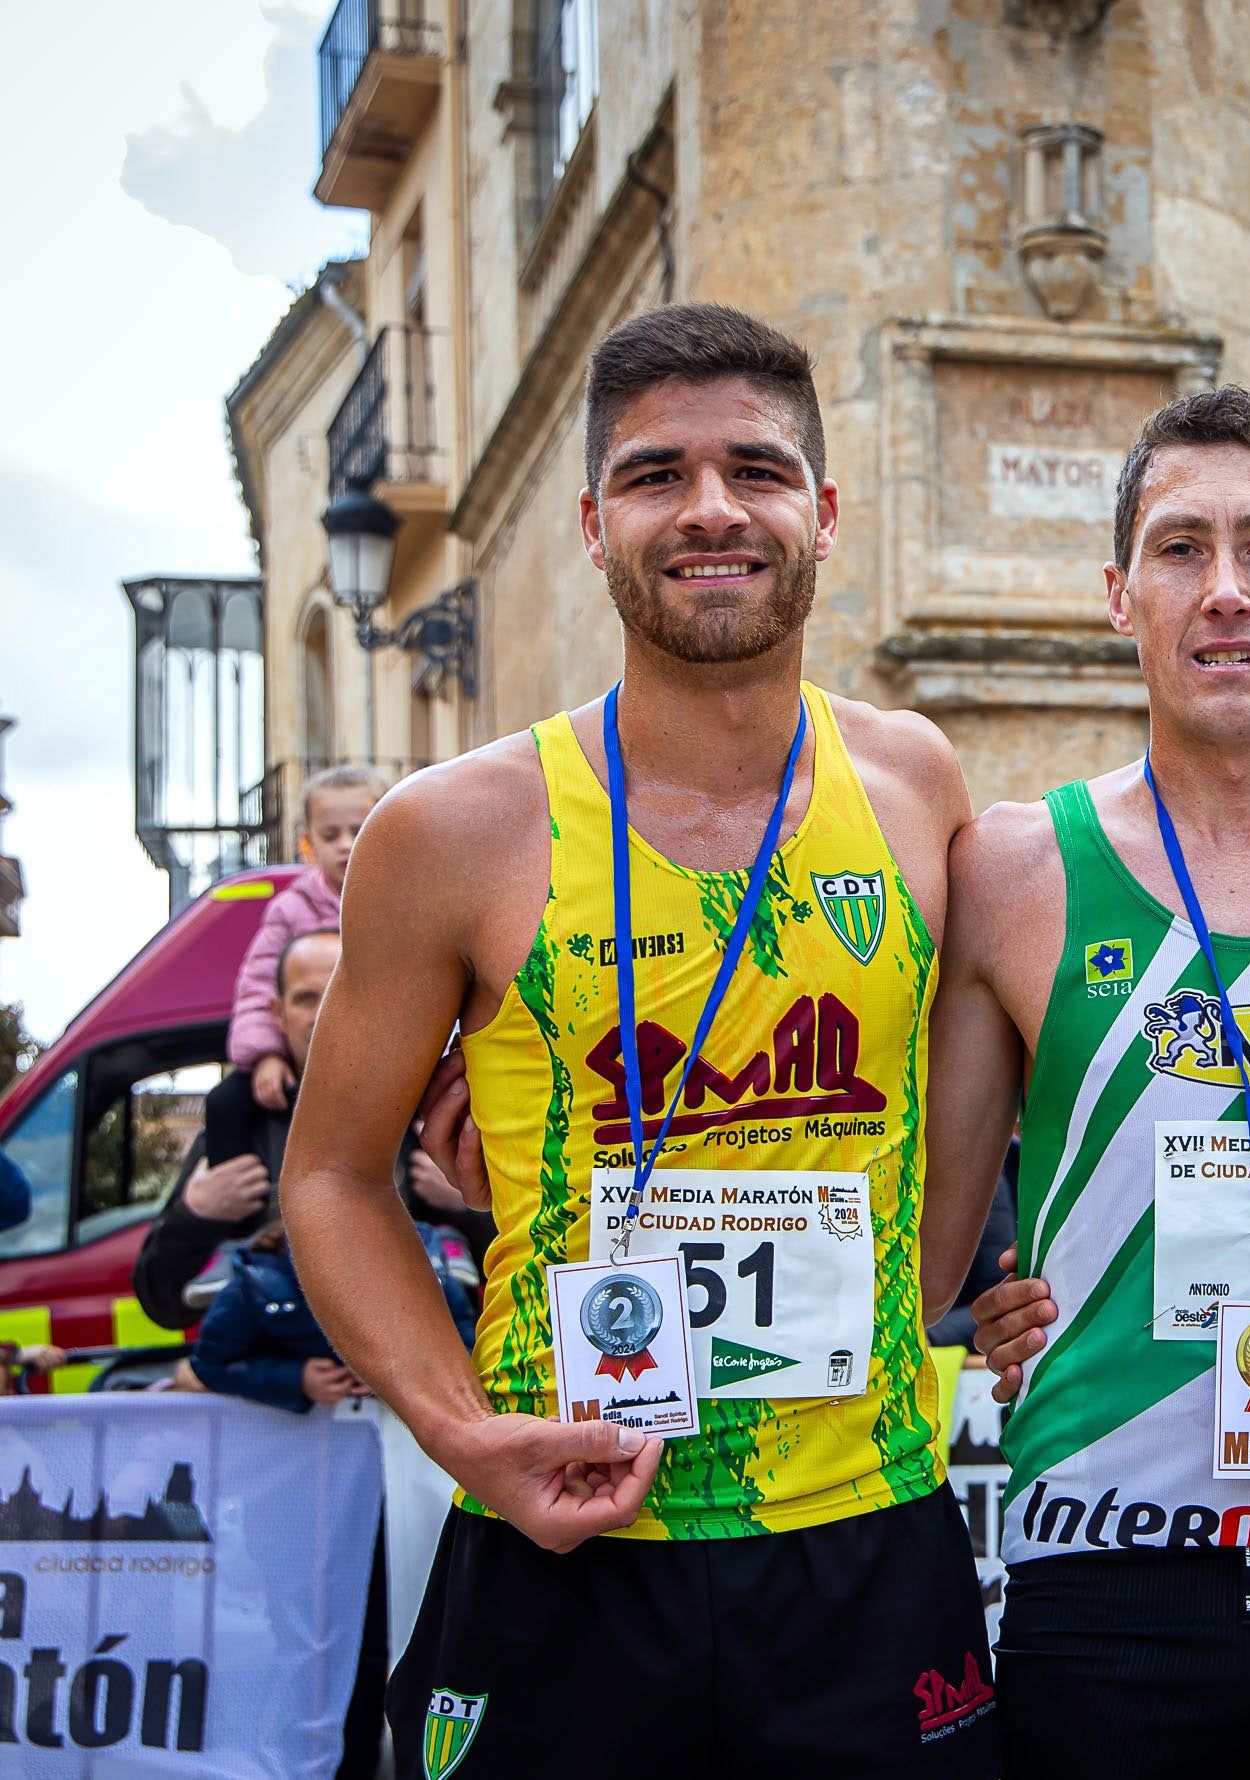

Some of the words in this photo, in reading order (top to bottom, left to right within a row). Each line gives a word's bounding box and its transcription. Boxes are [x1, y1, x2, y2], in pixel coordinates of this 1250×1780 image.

[1002, 457, 1104, 489] MAYOR
[821, 878, 878, 896] CDT
[1086, 980, 1133, 999] seia
[585, 991, 887, 1144] SPMAQ
[703, 1125, 792, 1149] Projetos
[804, 1115, 886, 1141] Máquinas
[1170, 1163, 1195, 1179] DE
[650, 1186, 715, 1204] MEDIA
[720, 1184, 814, 1205] MARATÓN
[639, 1212, 716, 1231] CIUDAD
[720, 1213, 808, 1232] RODRIGO
[834, 1207, 859, 1220] 2024
[677, 1241, 775, 1329] 51
[1188, 1282, 1230, 1297] ANTONIO
[608, 1296, 634, 1331] 2
[1175, 1311, 1207, 1323] oeste
[610, 1343, 637, 1356] 2024
[34, 1553, 124, 1575] ciudad
[129, 1553, 216, 1577] rodrigo
[920, 1724, 956, 1744] Soluções
